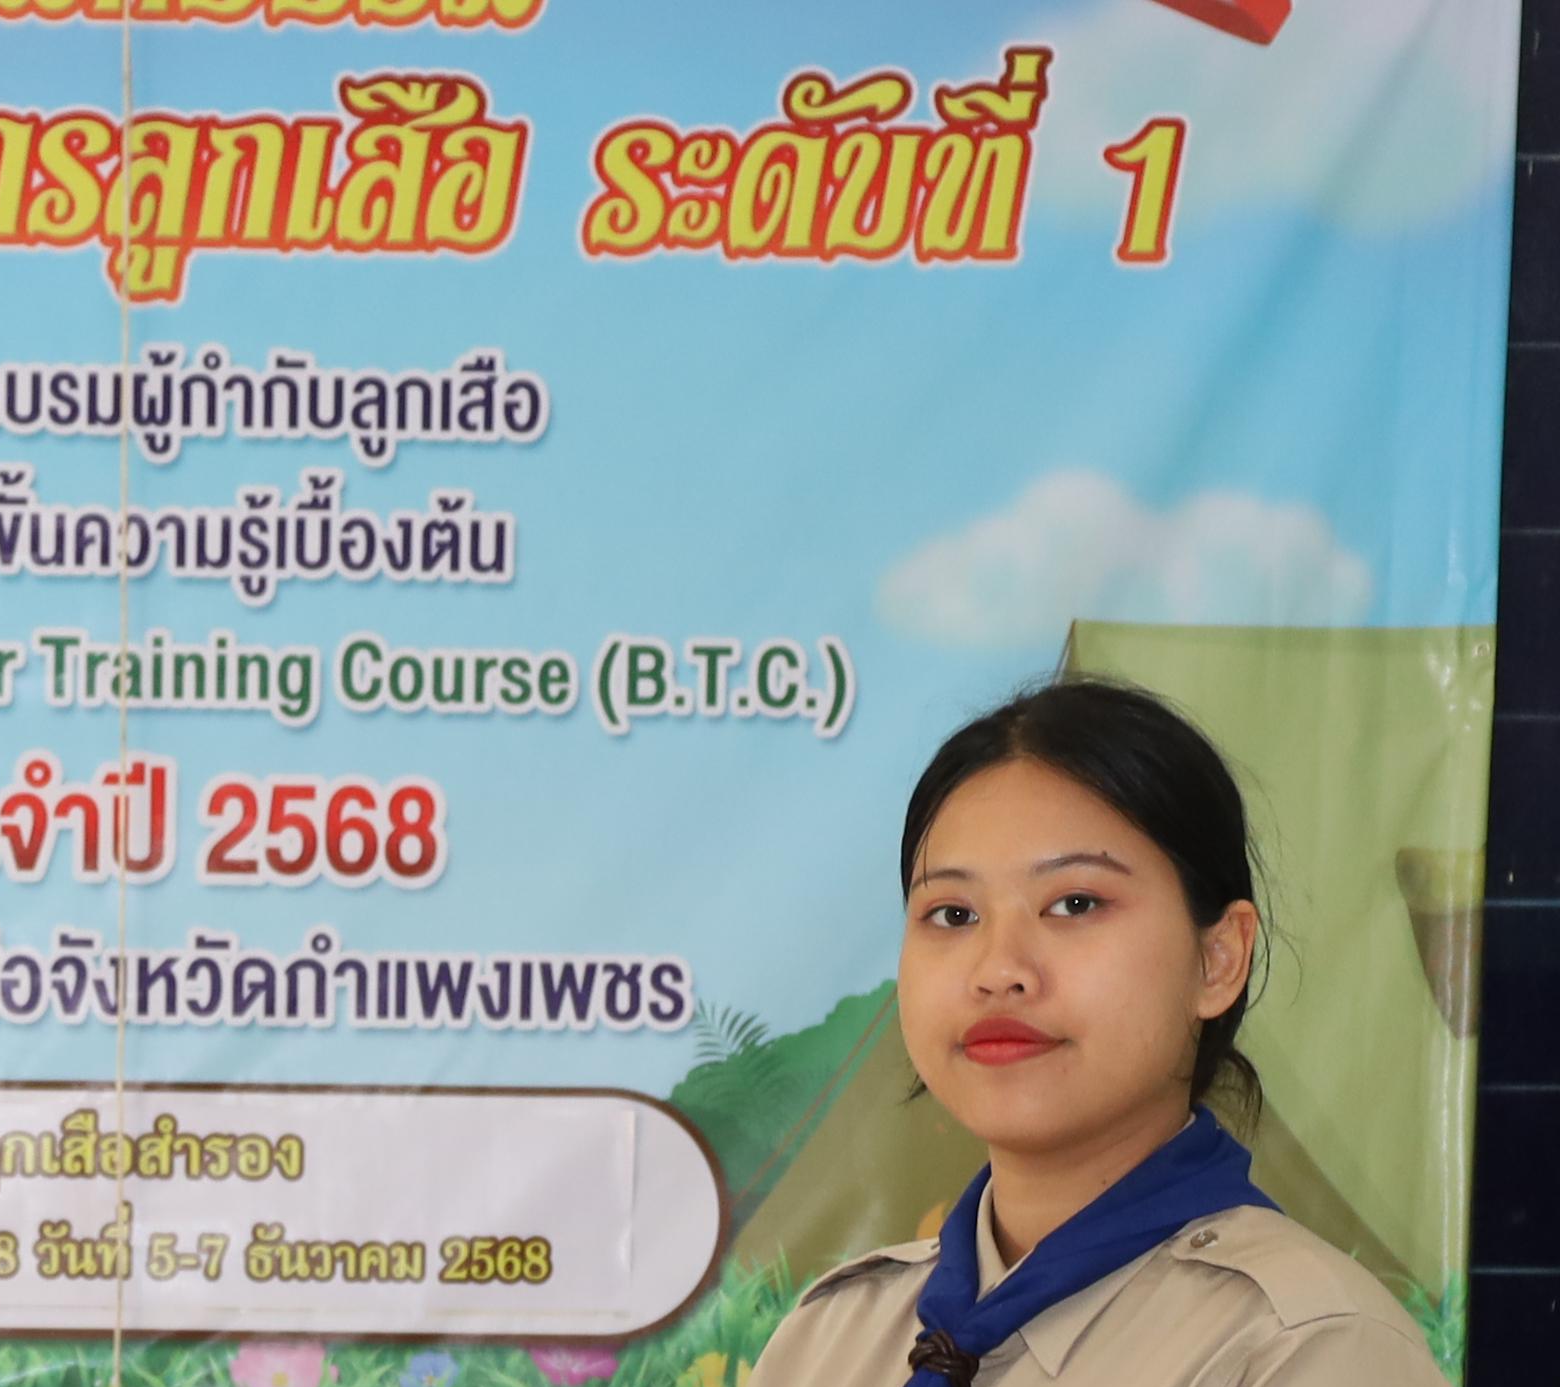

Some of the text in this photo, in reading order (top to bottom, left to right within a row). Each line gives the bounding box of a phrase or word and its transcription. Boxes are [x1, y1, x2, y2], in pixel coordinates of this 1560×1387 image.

[584, 47, 1053, 262] ระดับที่
[1103, 117, 1184, 264] 1
[40, 633, 313, 714] Training
[340, 643, 571, 709] Course
[597, 642, 853, 730] (B.T.C.)
[204, 780, 440, 881] 2568
[34, 1202, 133, 1281] วันที่
[147, 1231, 227, 1281] 5-7
[246, 1222, 425, 1282] ธันวาคม
[439, 1234, 553, 1285] 2568
